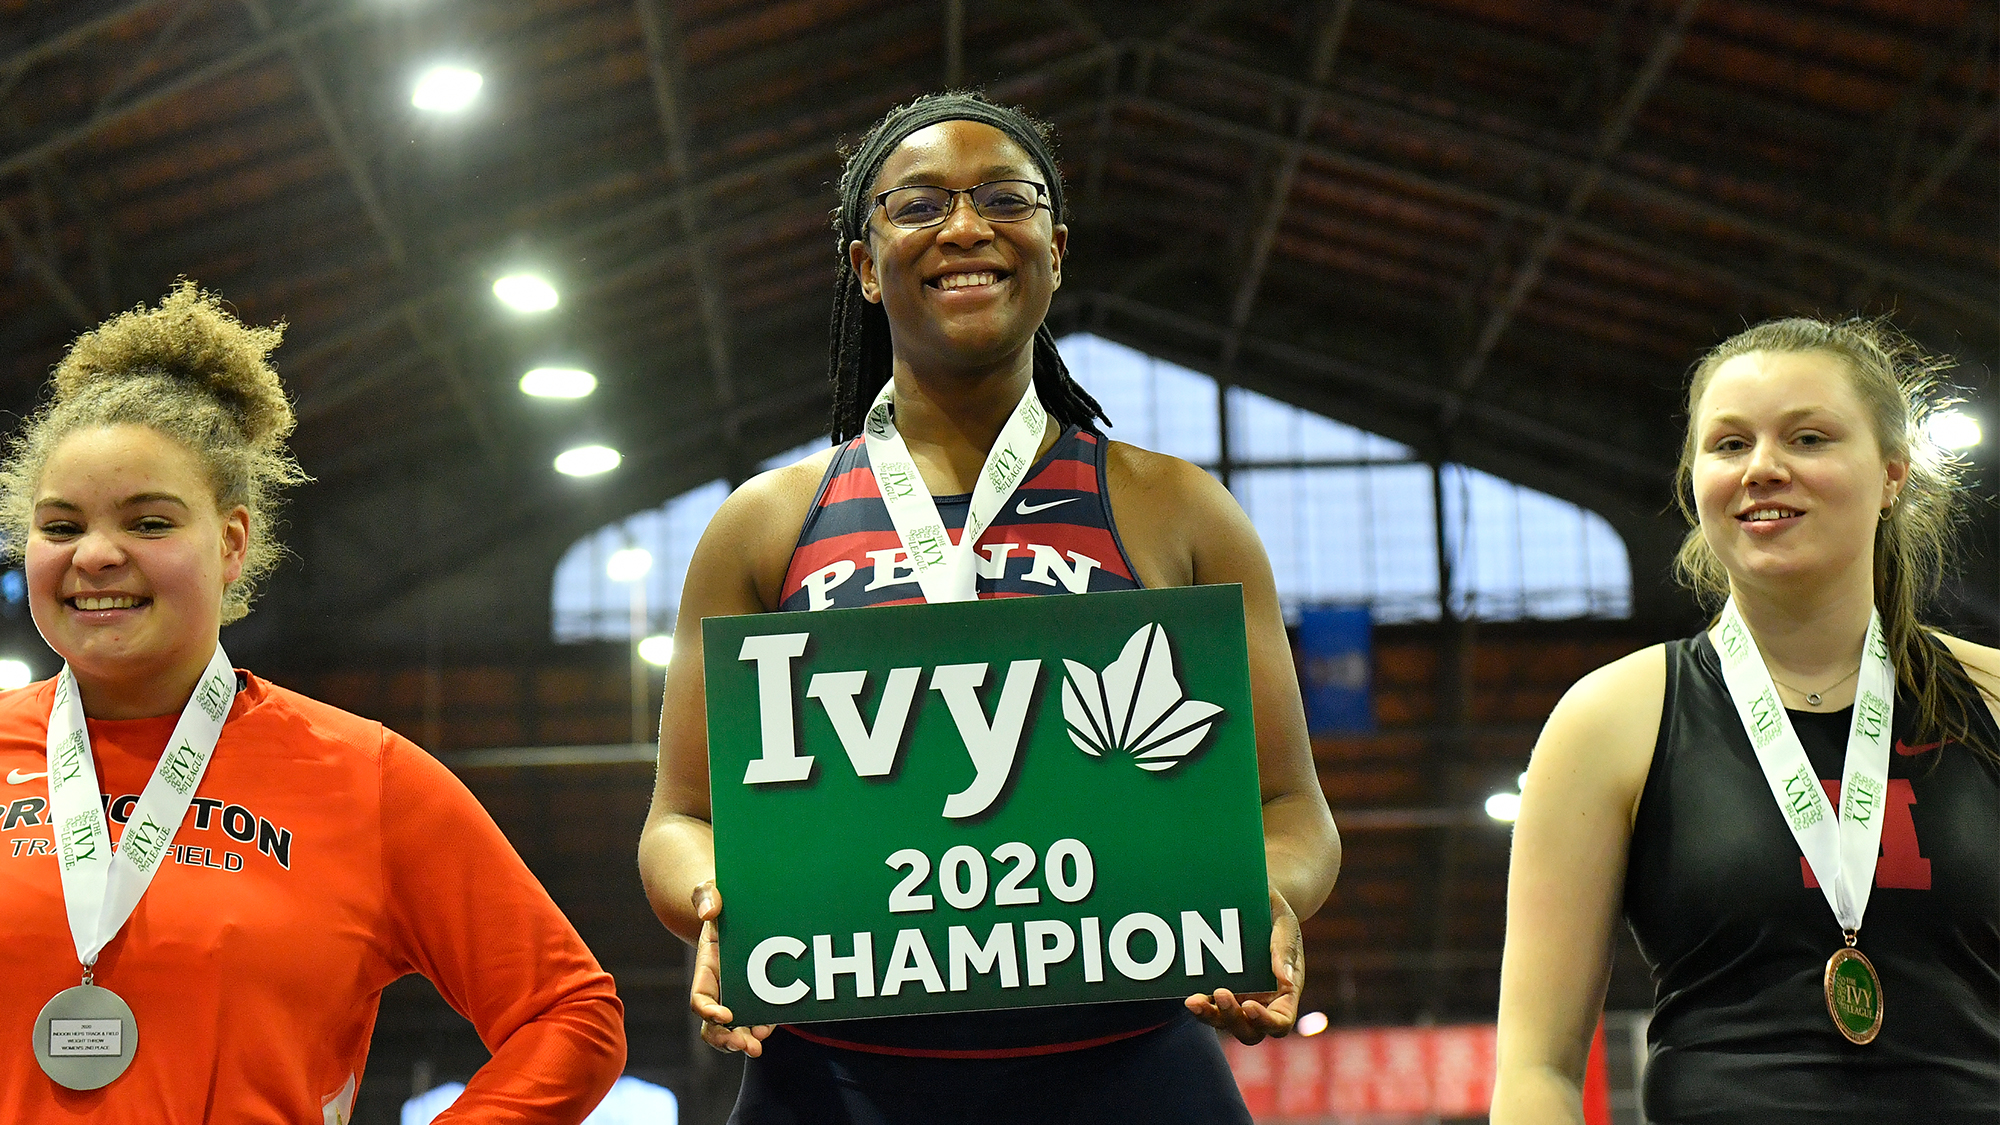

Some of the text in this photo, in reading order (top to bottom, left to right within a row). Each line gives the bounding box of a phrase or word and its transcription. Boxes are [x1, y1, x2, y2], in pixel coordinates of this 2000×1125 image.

[991, 451, 1000, 464] THE
[994, 442, 1018, 480] IVY
[888, 471, 917, 498] IVY
[918, 537, 947, 566] IVY
[936, 534, 946, 547] THE
[1721, 623, 1742, 658] IVY
[201, 679, 211, 693] THE
[206, 668, 226, 708] IVY
[737, 632, 1043, 819] Ivy
[1748, 695, 1774, 734] IVY
[1864, 706, 1882, 746] IVY
[60, 744, 82, 782] IVY
[164, 751, 176, 766] THE
[170, 738, 197, 781] IVY
[1782, 774, 1812, 814] IVY
[1784, 802, 1796, 820] THE
[1852, 788, 1873, 830] IVY
[1873, 794, 1881, 810] THE
[72, 824, 97, 862] IVY
[92, 821, 101, 836] THE
[126, 828, 136, 846] THE
[132, 814, 160, 858] IVY
[884, 838, 1094, 912] 2020
[746, 907, 1244, 1005] CHAMPION
[1846, 985, 1872, 1009] IVY
